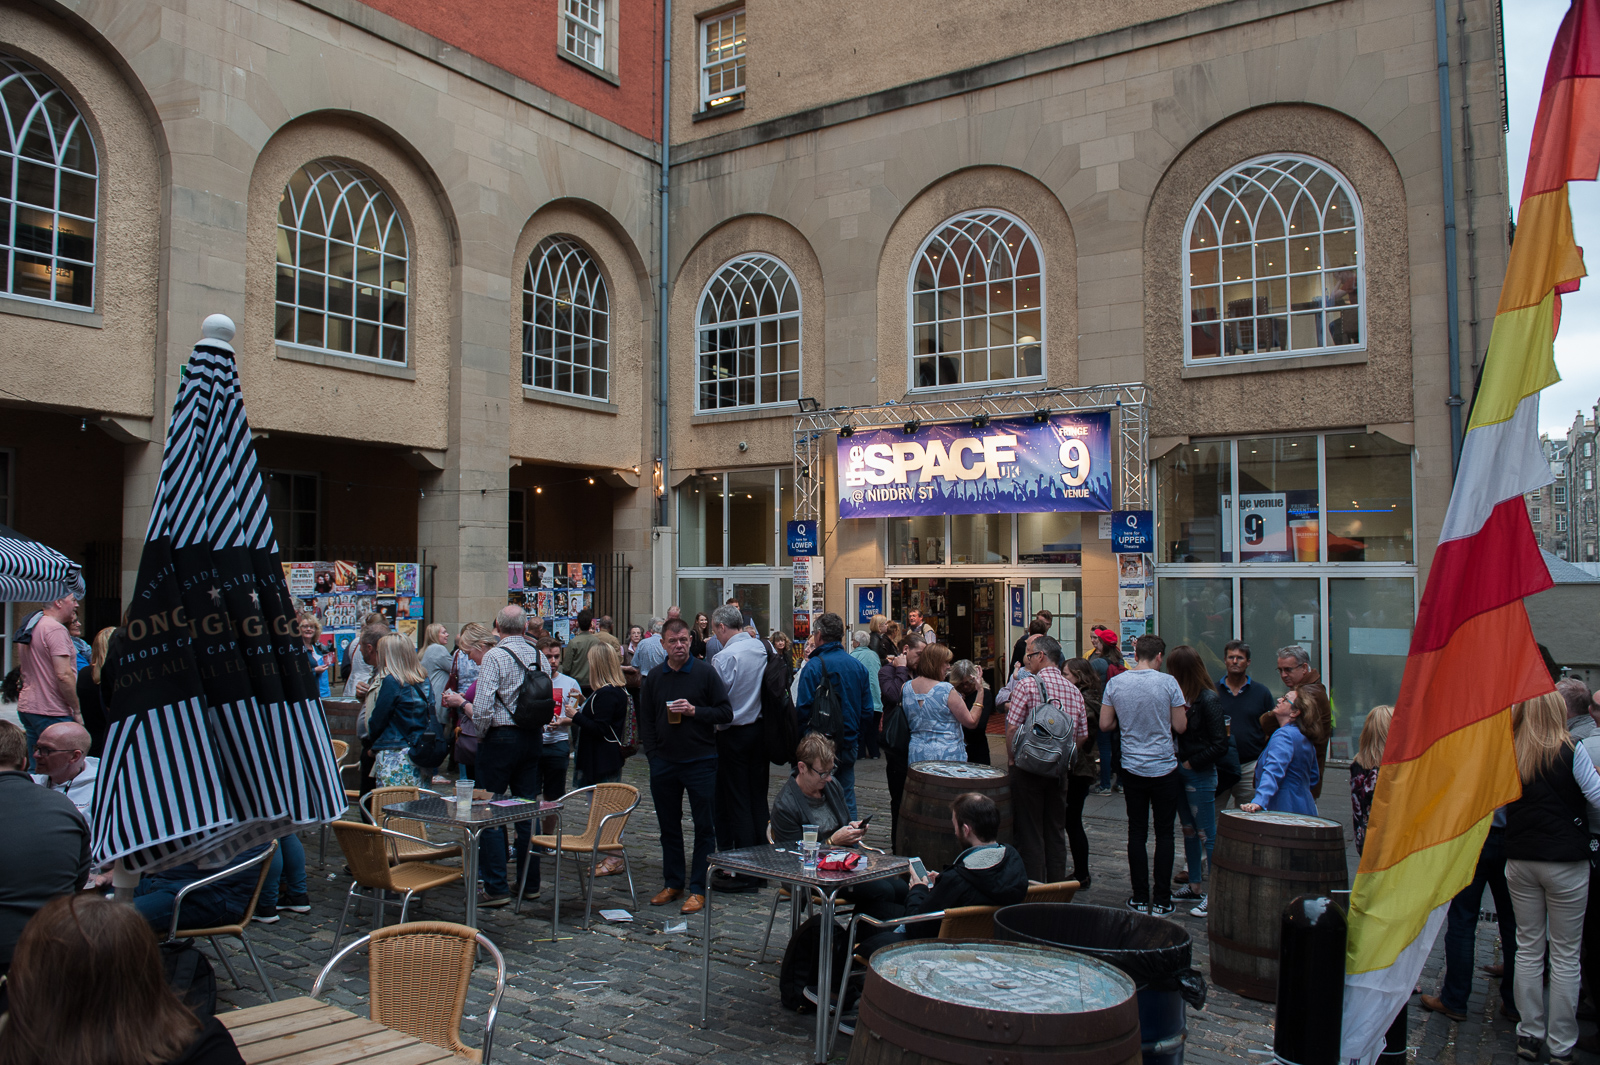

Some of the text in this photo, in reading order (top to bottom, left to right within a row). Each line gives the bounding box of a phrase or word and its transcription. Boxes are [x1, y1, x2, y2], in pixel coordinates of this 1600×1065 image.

[1058, 426, 1088, 436] FRINGE
[846, 445, 866, 487] the
[1058, 438, 1090, 487] 9
[852, 485, 935, 502] @ NIDDRY ST
[1062, 488, 1090, 498] VENUE
[1224, 498, 1284, 510] frge venue
[1126, 514, 1138, 528] Q
[797, 524, 806, 536] Q
[1244, 514, 1264, 546] 9
[1118, 536, 1146, 544] UPPER
[867, 590, 874, 603] Q
[862, 608, 879, 616] LOWER
